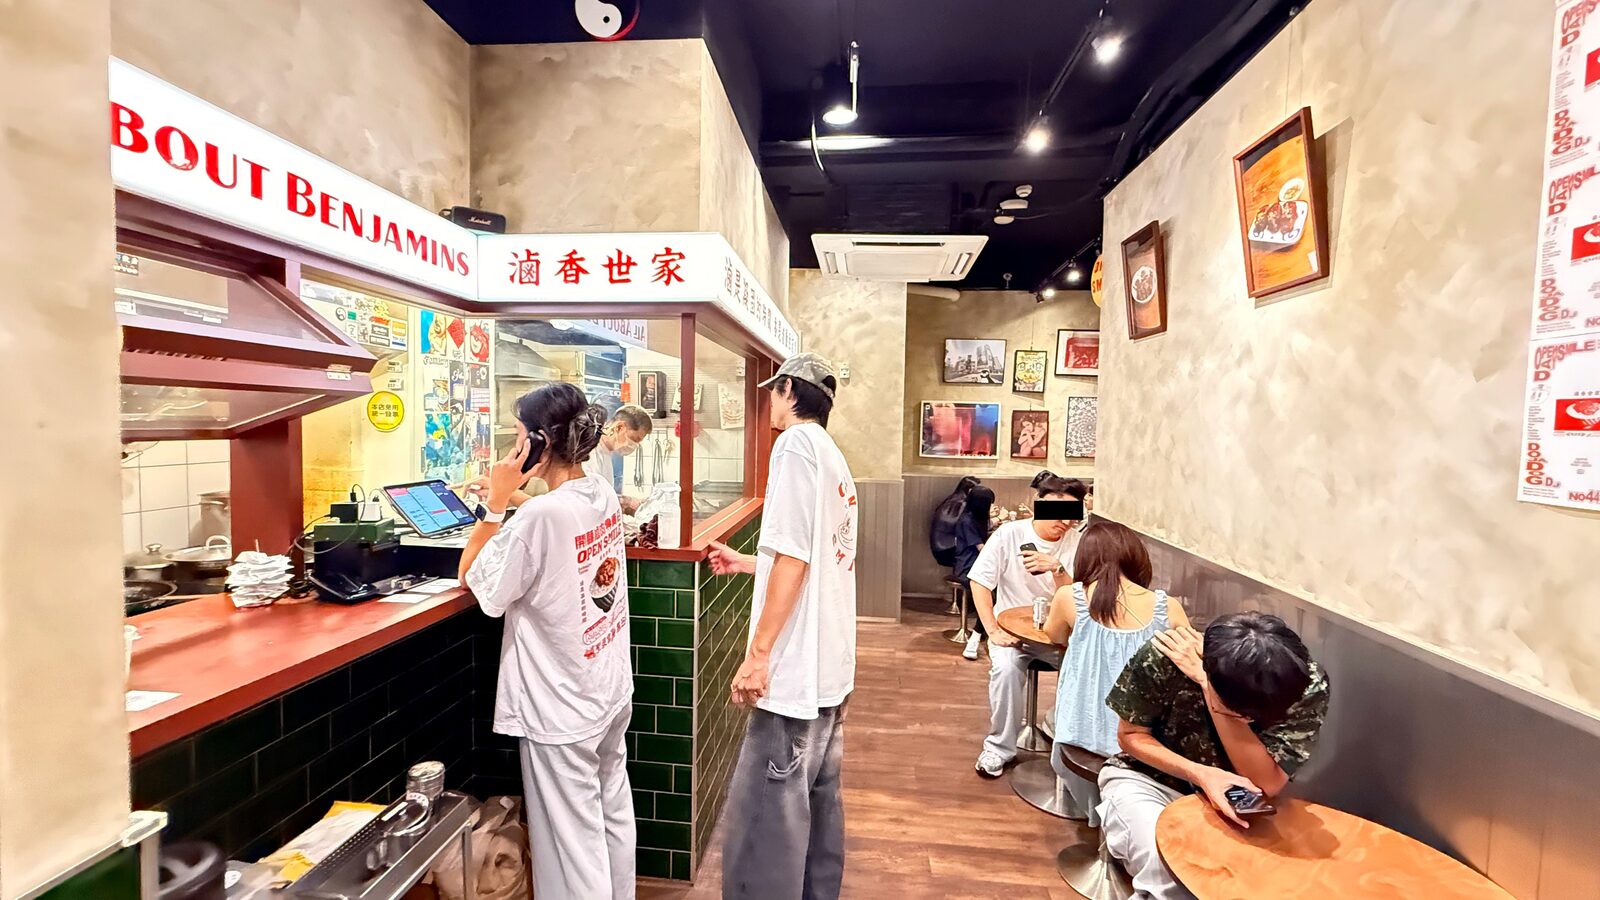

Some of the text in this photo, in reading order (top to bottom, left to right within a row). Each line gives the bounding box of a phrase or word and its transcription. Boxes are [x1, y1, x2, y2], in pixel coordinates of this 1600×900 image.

[287, 171, 470, 277] BENJAMINS
[508, 246, 686, 287] 滷香世家
[577, 540, 602, 564] OPEN
